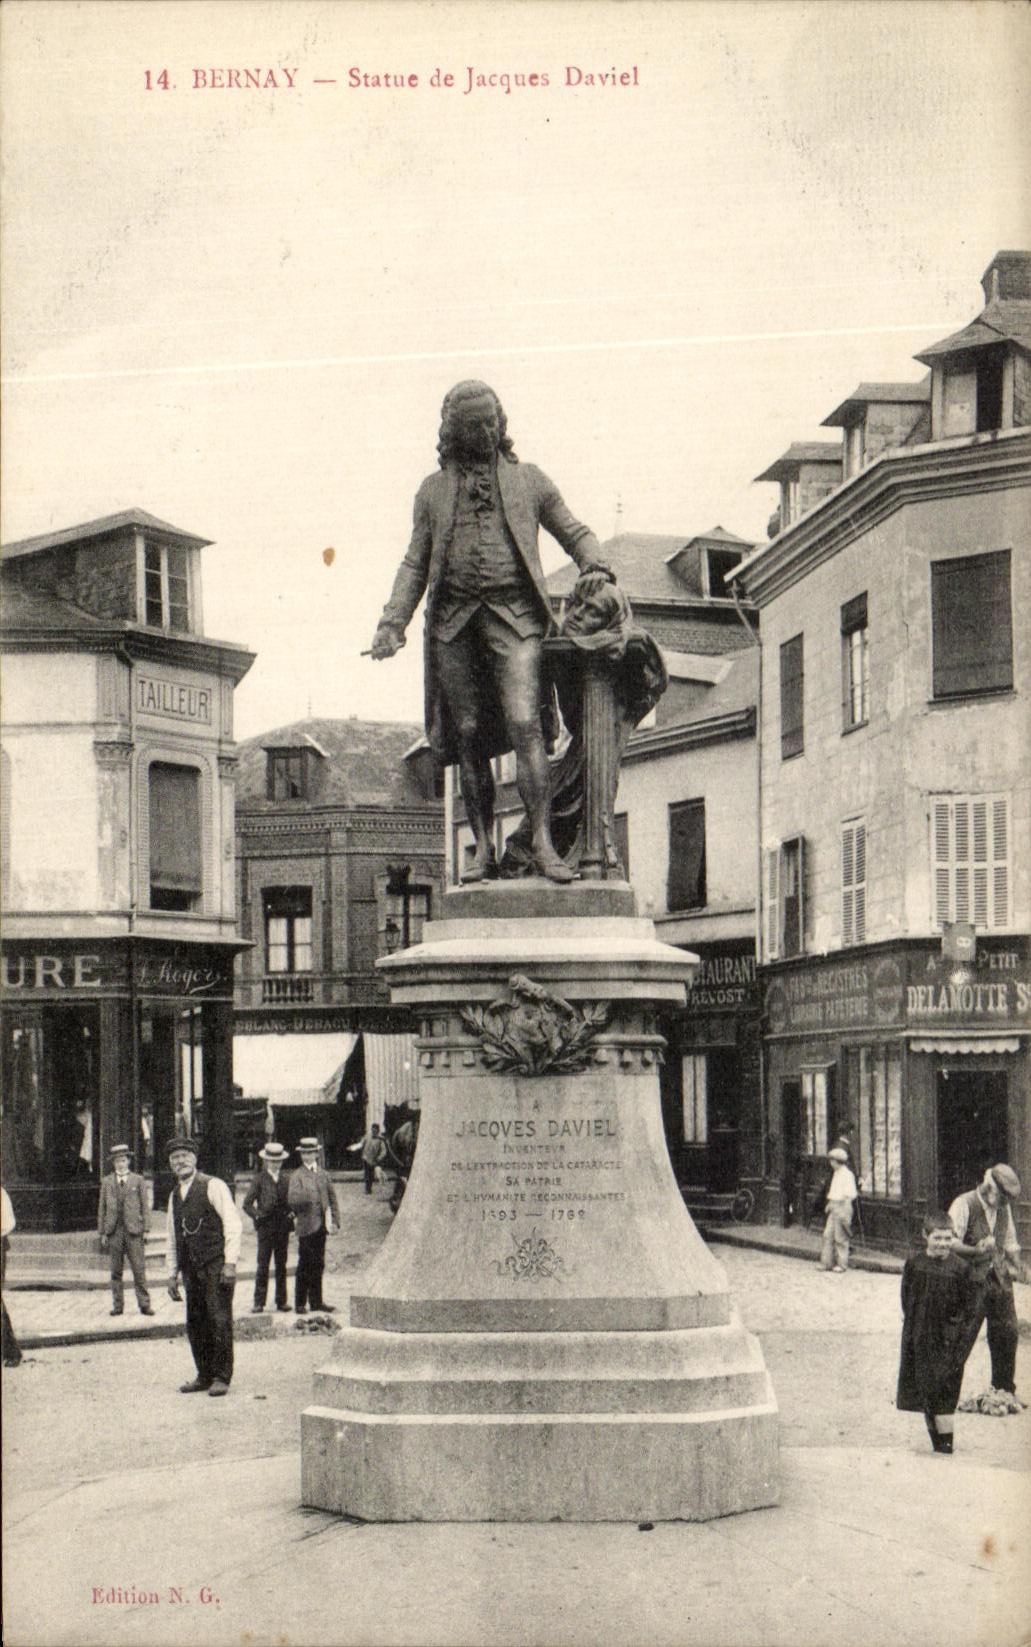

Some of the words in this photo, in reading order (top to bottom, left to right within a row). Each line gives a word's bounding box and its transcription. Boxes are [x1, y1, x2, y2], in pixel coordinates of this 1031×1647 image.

[138, 678, 210, 719] TAILLEUR
[906, 982, 1009, 1013] DELAMOTTE
[547, 1119, 617, 1138] DAVIEL
